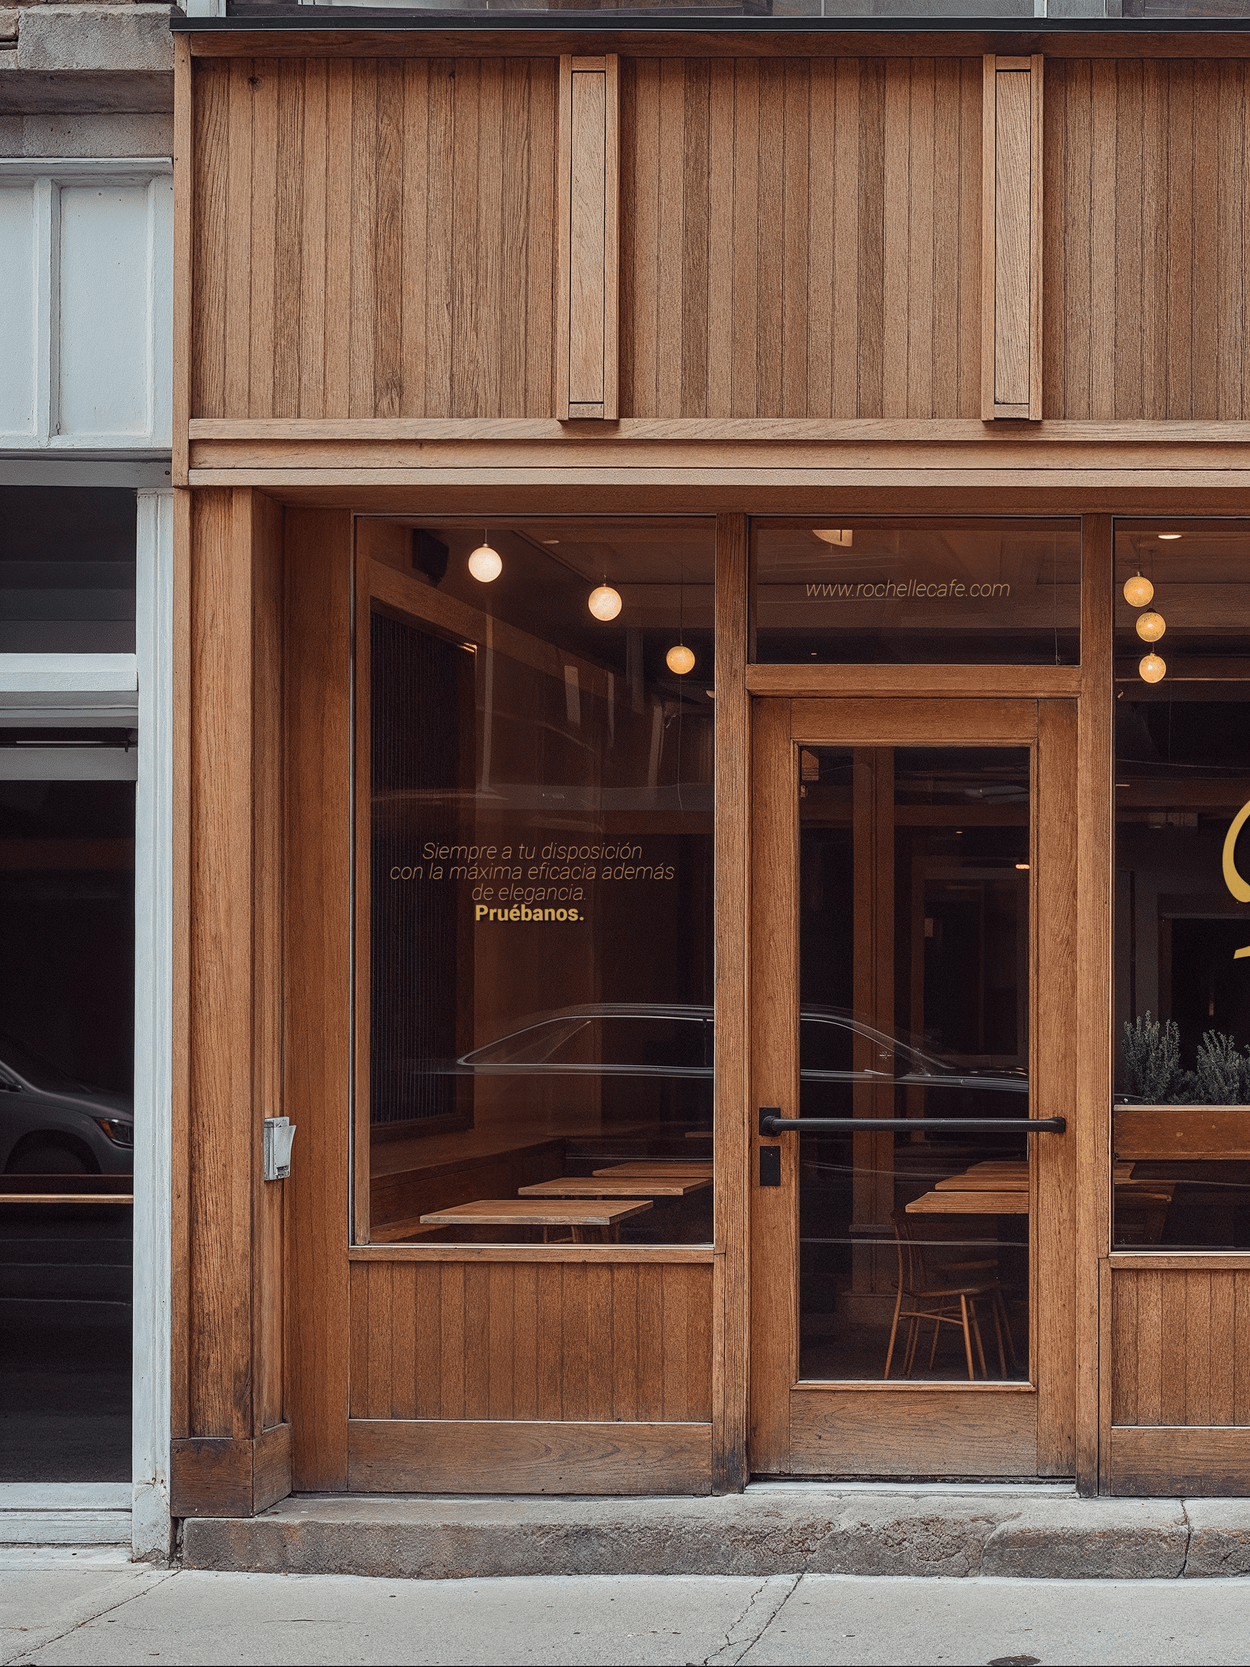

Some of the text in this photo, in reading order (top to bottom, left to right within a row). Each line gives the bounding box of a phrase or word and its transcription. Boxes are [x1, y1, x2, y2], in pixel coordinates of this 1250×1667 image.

[806, 578, 1011, 598] www.rochellecafe.com
[422, 841, 643, 864] Siempre a tu disposición
[389, 861, 676, 880] con la máxima eficacia además
[471, 883, 587, 905] de elegancia.
[475, 903, 585, 922] Pruébanos.
